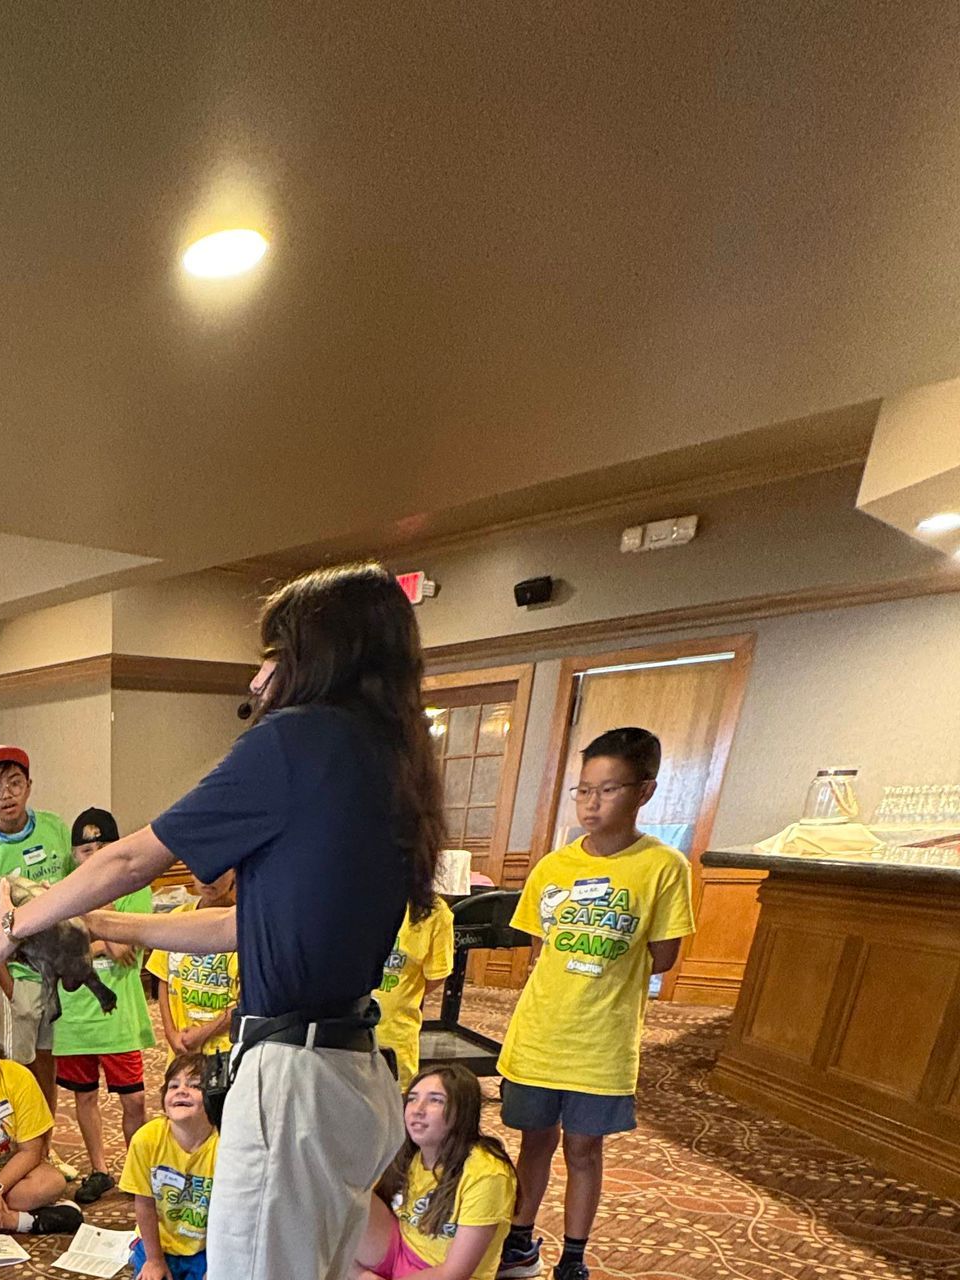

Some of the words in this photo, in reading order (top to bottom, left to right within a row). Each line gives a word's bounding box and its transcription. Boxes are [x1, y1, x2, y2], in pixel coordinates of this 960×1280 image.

[559, 906, 640, 934] SAFARI
[554, 931, 630, 960] CAMP
[166, 1207, 209, 1228] CAM
